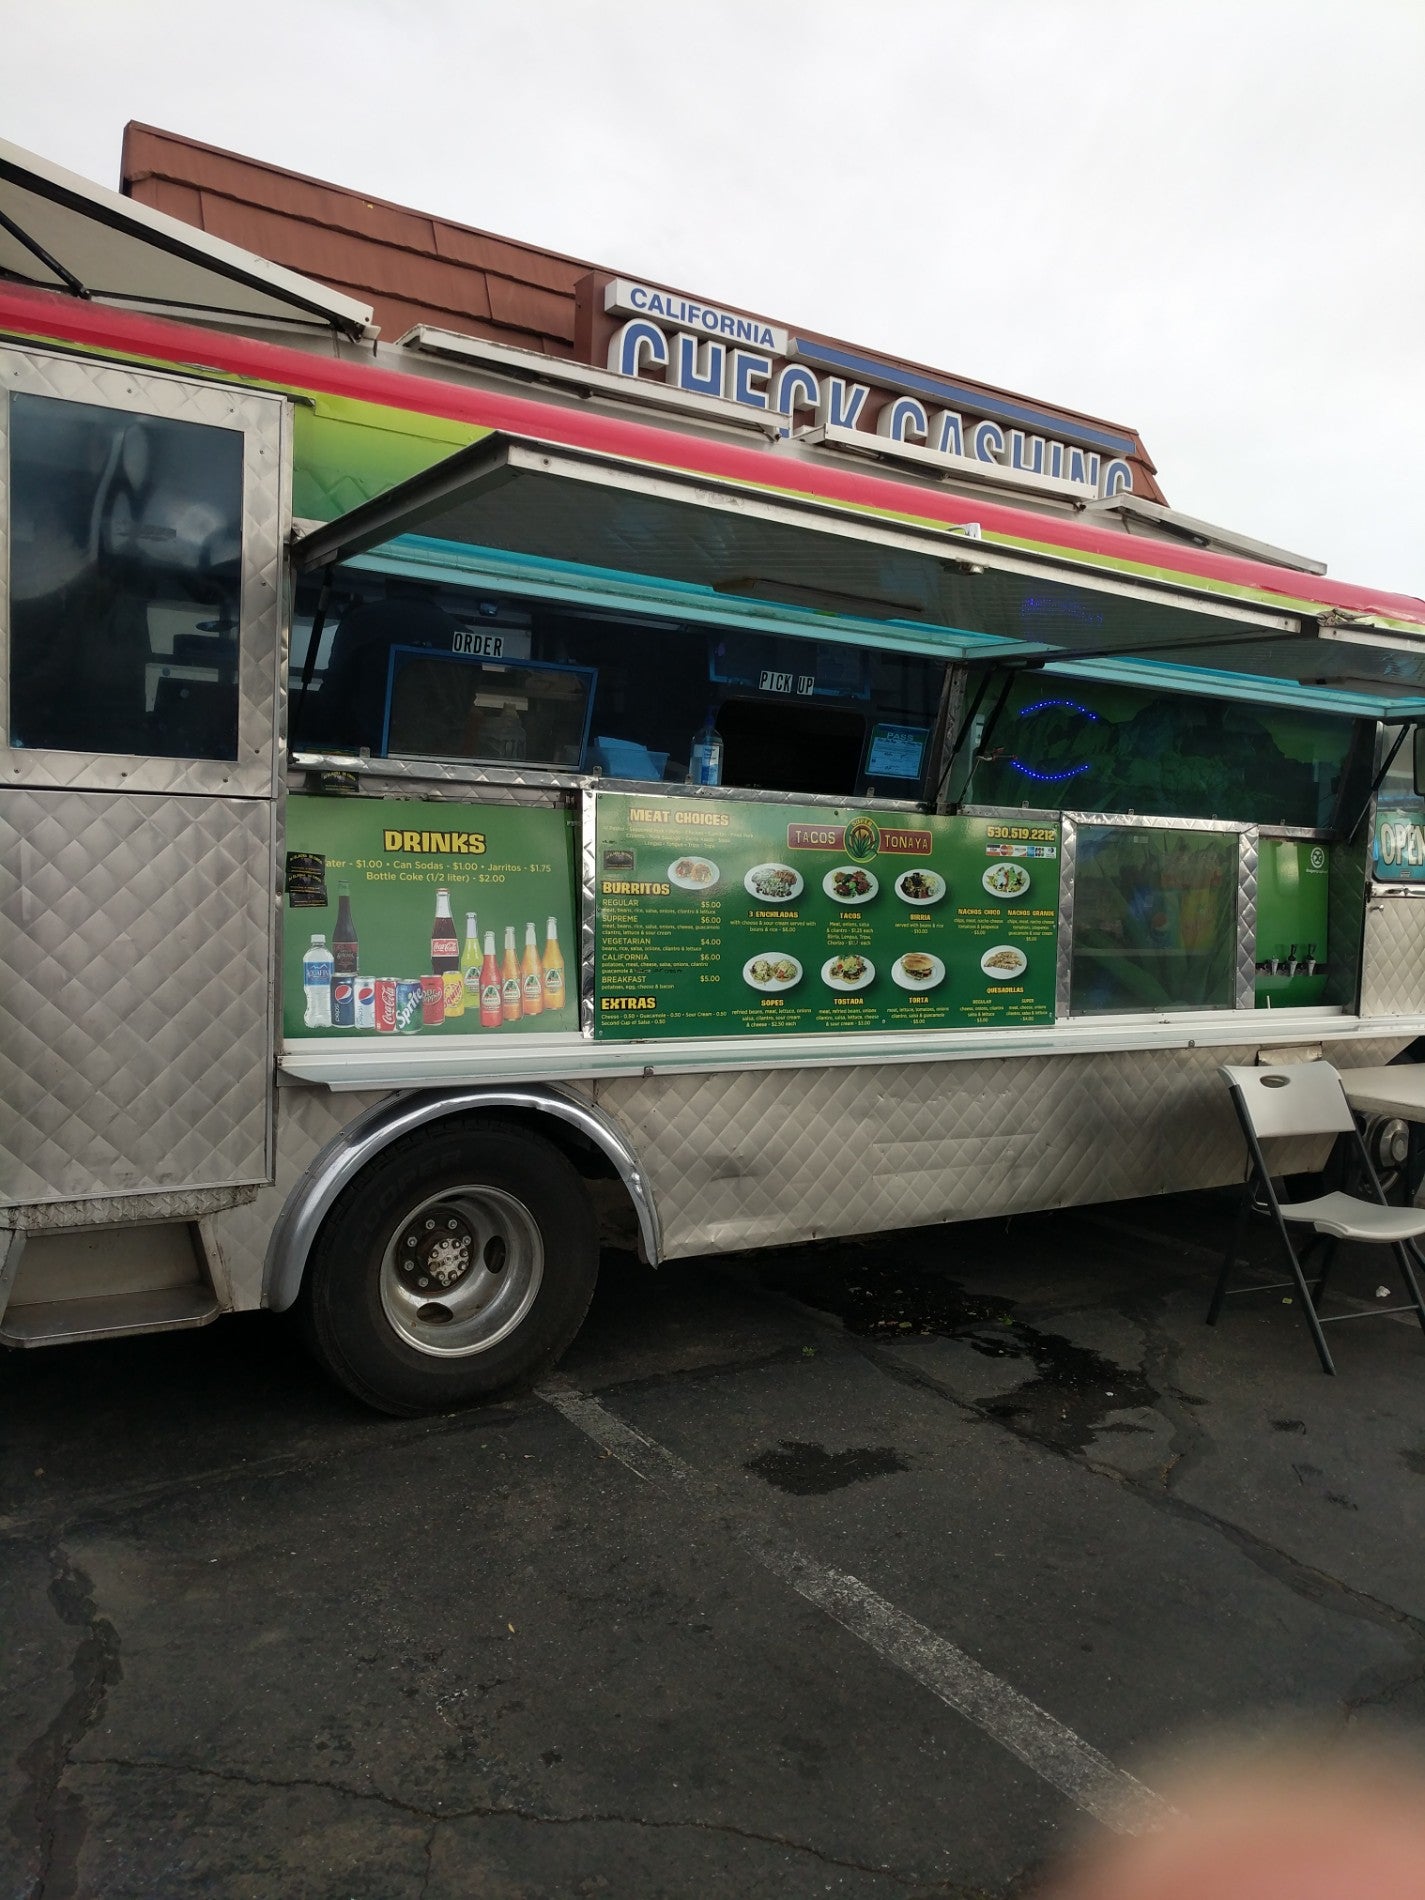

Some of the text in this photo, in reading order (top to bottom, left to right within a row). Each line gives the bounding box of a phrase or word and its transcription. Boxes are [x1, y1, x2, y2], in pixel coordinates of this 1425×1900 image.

[630, 288, 774, 348] CALIFORNIA
[454, 634, 502, 656] ORDER
[761, 672, 813, 693] PICK UP
[630, 809, 728, 825] MEAT CHOICES
[796, 831, 835, 844] TACOS
[885, 835, 928, 848] TONAYA
[987, 826, 1055, 840] 530.519.2212
[385, 830, 486, 854] DRINKS
[356, 860, 382, 868] $1.00
[394, 861, 412, 869] Can
[415, 861, 443, 870] Sodas
[453, 862, 477, 870] $1.00
[488, 864, 521, 872] Jarritos
[530, 864, 551, 872] $1.75
[366, 872, 396, 880] Bottle
[400, 872, 423, 881] Coke
[448, 873, 469, 882] liter)
[480, 874, 505, 883] $2.00
[603, 882, 670, 894] BURRITOS
[396, 988, 422, 1028] Sprite
[602, 998, 656, 1010] EXTRAS
